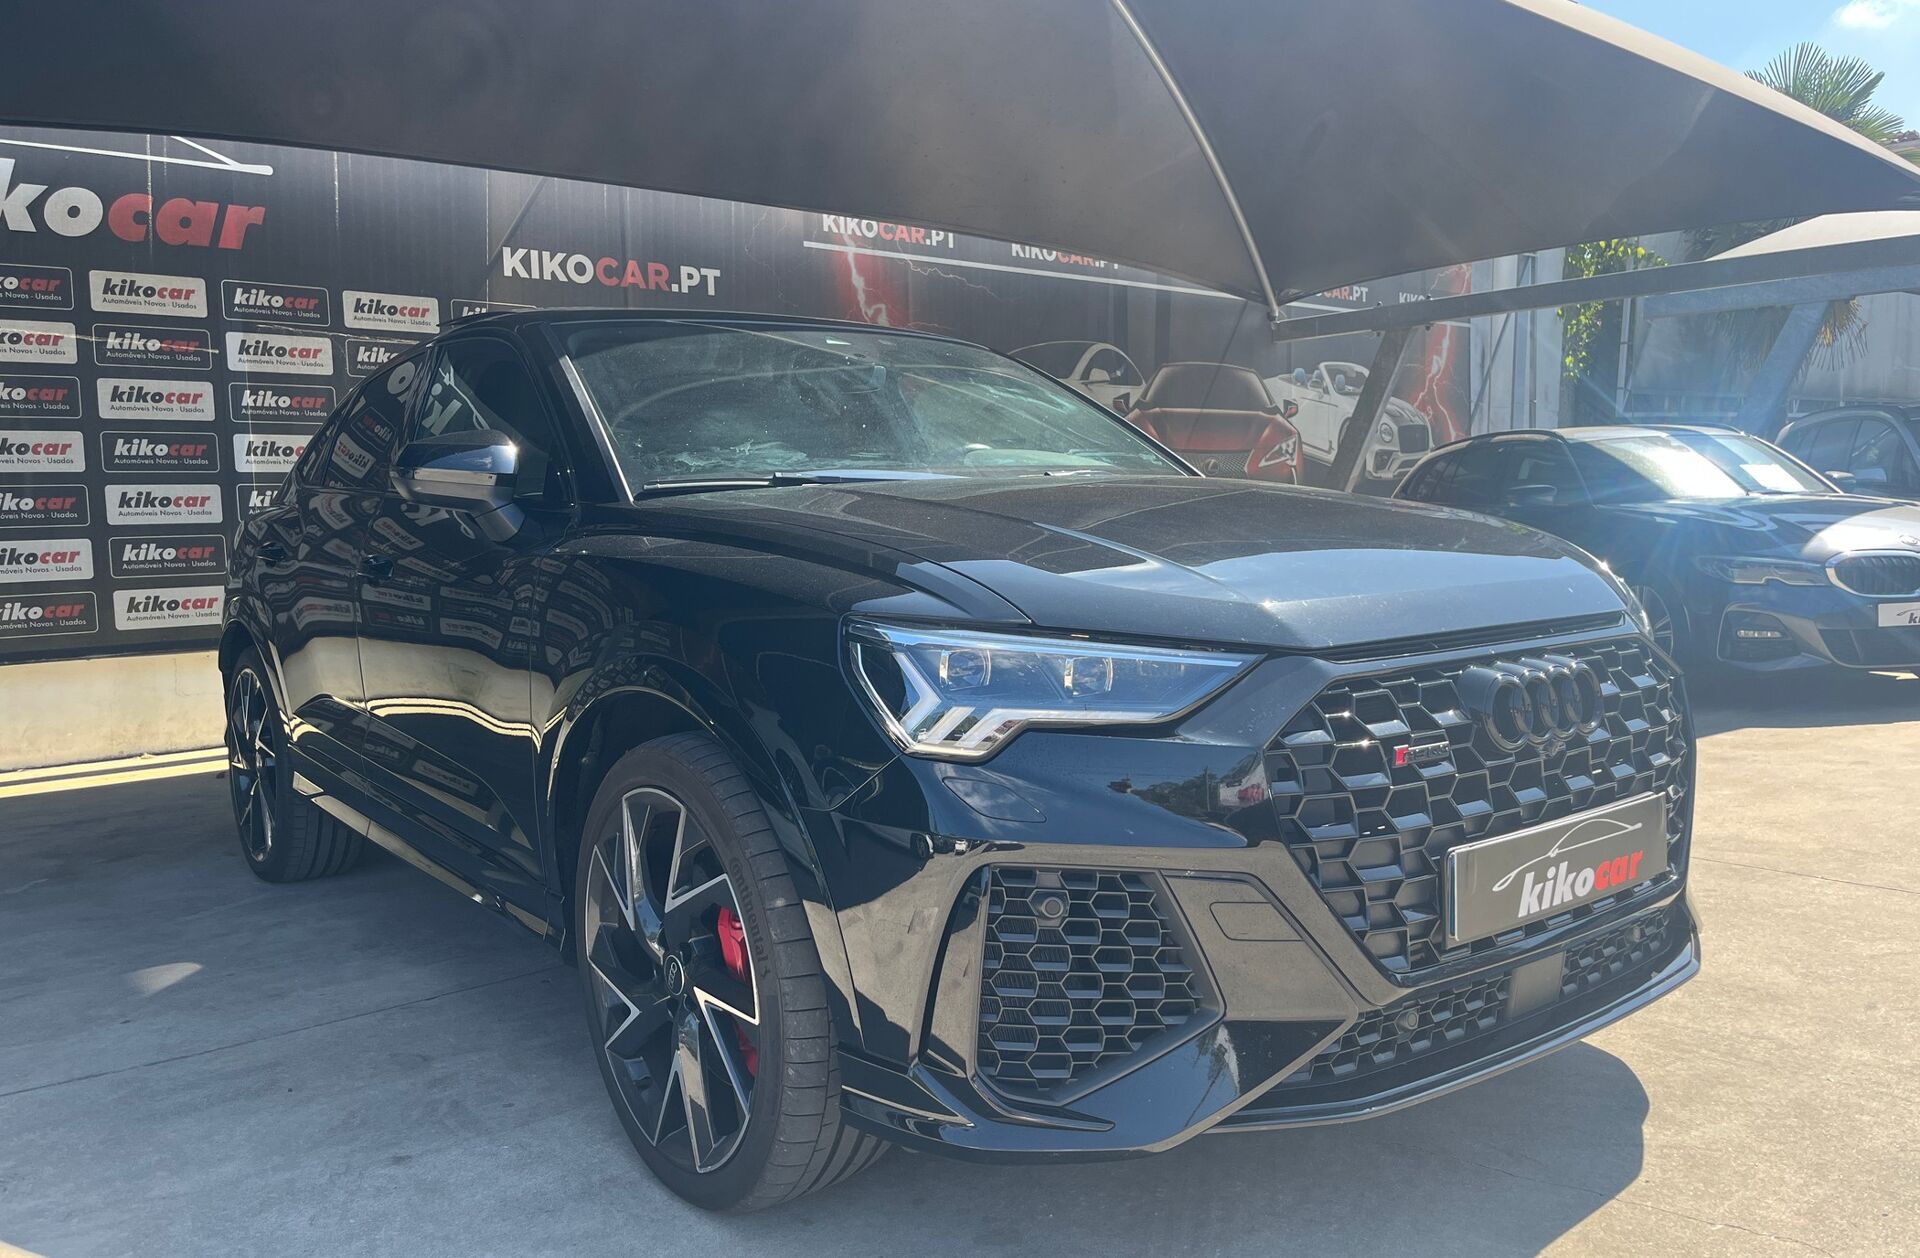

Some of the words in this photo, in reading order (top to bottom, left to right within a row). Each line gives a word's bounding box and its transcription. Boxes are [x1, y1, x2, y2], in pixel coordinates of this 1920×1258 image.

[502, 246, 721, 296] KIKOCAR.PT
[102, 278, 196, 300] kikocar
[172, 301, 197, 309] Usados
[234, 288, 318, 310] kikocar
[354, 298, 430, 318] kikocar
[106, 332, 199, 352] kikocar
[238, 340, 322, 358] kikocar
[40, 348, 66, 356] Usados
[301, 360, 324, 368] Usados
[110, 386, 203, 404] kikocar
[241, 390, 326, 408] kikocar
[180, 406, 204, 414] Usados
[114, 438, 208, 456] kikocar
[118, 491, 210, 508] kikocar
[122, 544, 215, 561] kikocar
[126, 596, 218, 614] kikocar
[196, 610, 220, 618] Usados
[1518, 850, 1644, 918] kikocar
